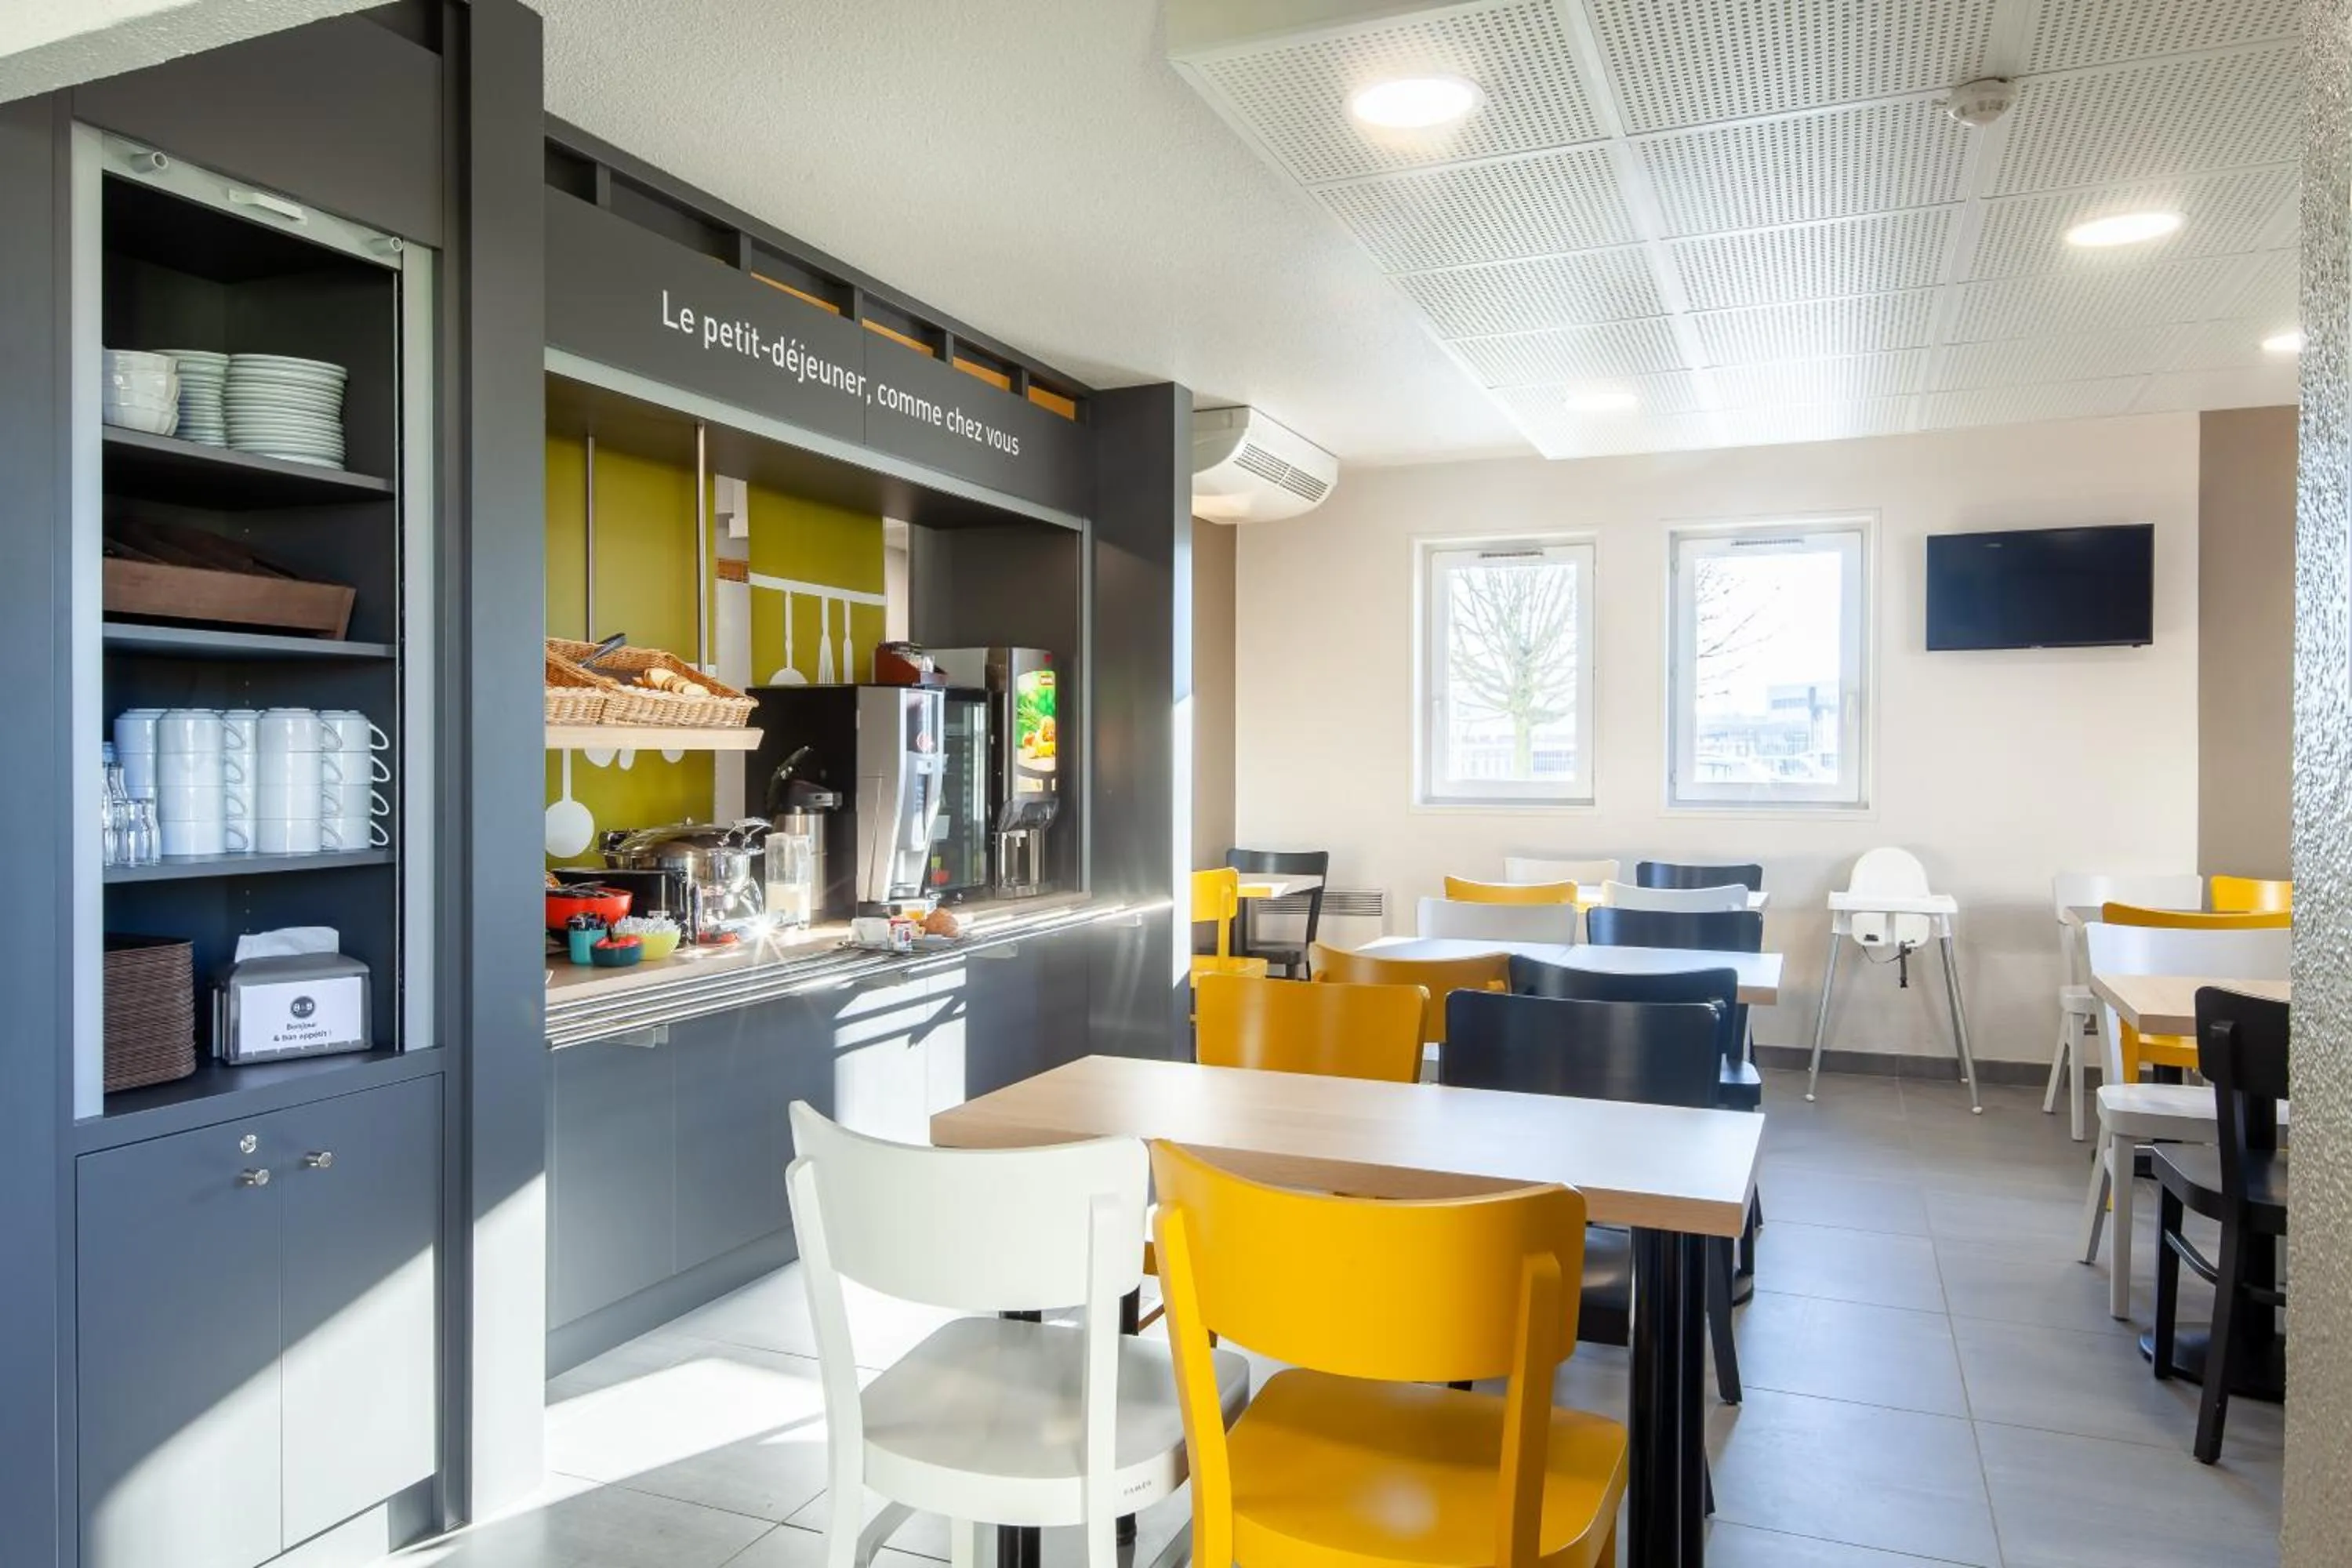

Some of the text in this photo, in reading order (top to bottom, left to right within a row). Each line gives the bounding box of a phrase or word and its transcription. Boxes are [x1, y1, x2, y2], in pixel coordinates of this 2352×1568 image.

[662, 290, 1019, 456] Le petit-déjeuner, comme chez vous
